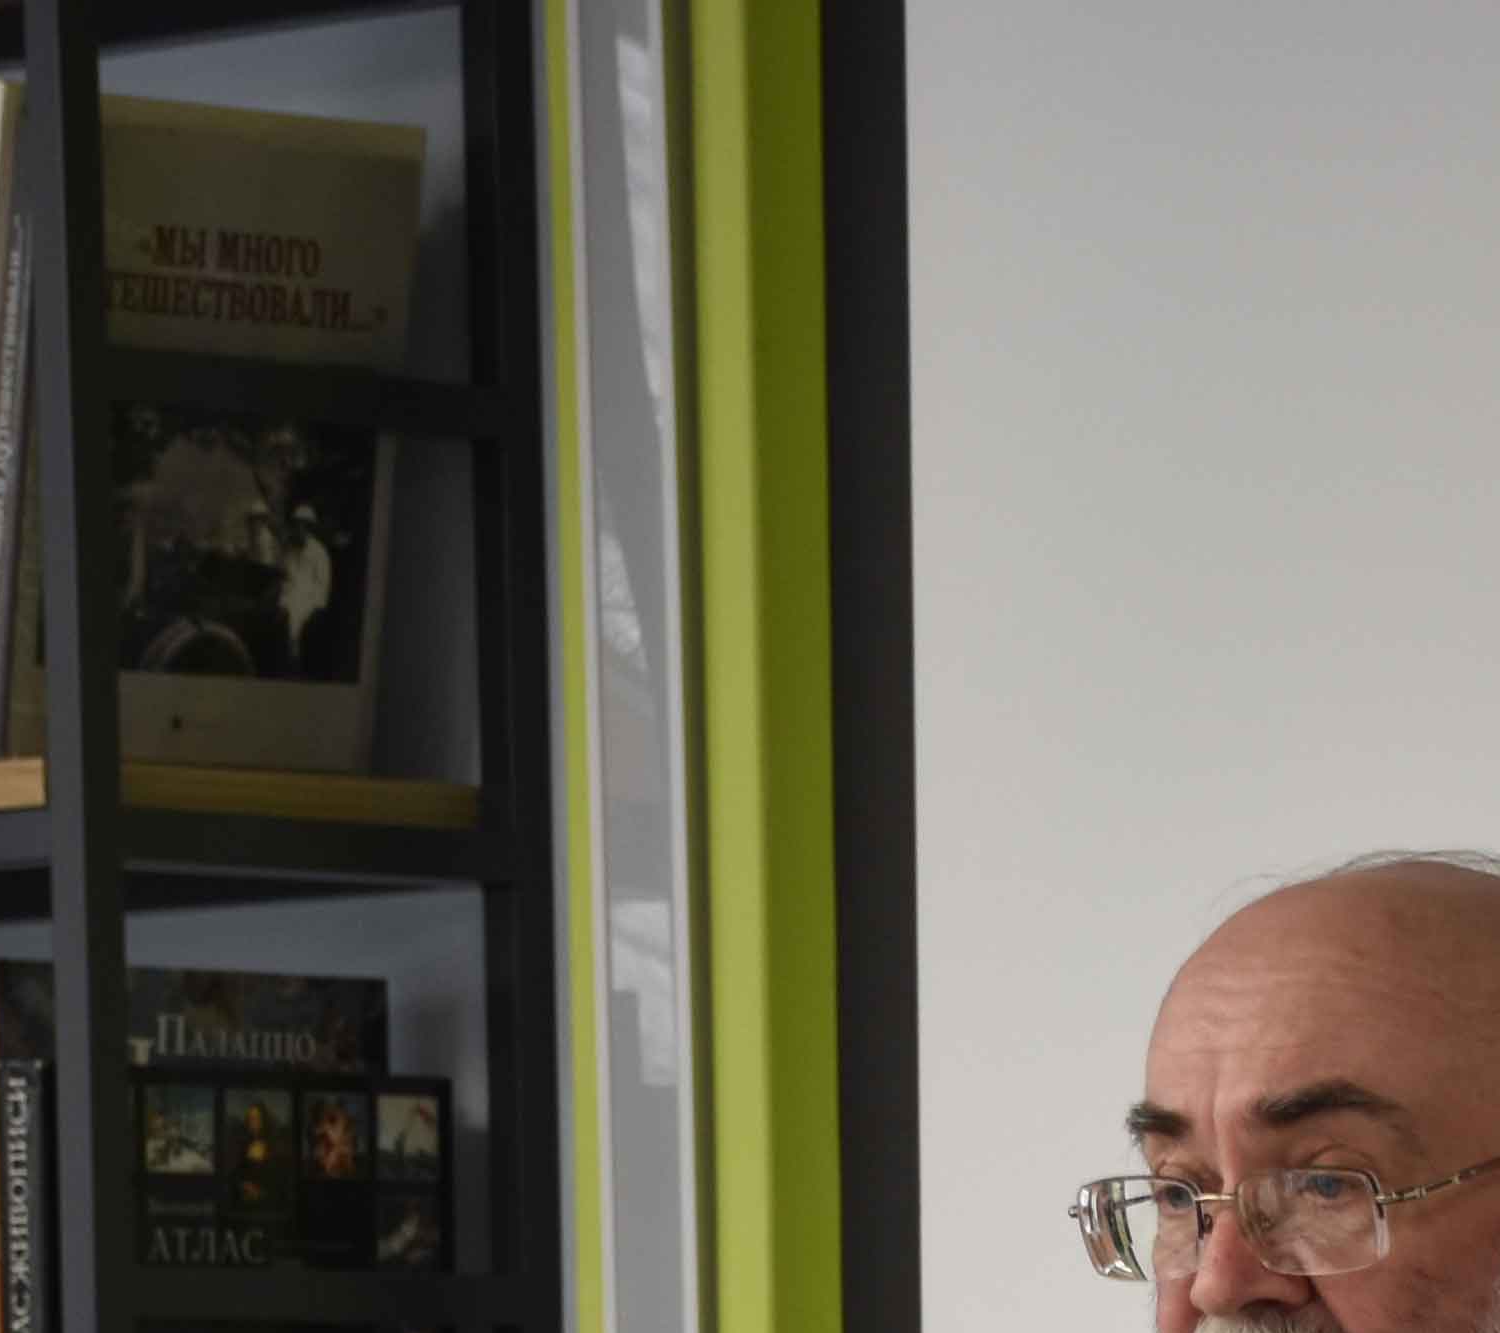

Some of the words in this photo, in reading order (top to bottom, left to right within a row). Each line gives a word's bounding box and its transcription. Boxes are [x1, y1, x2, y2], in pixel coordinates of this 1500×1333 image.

[216, 228, 323, 279] МНОГО
[6, 1076, 31, 1283] ЖИВОПИСИ
[148, 1226, 267, 1265] АТЛАС
